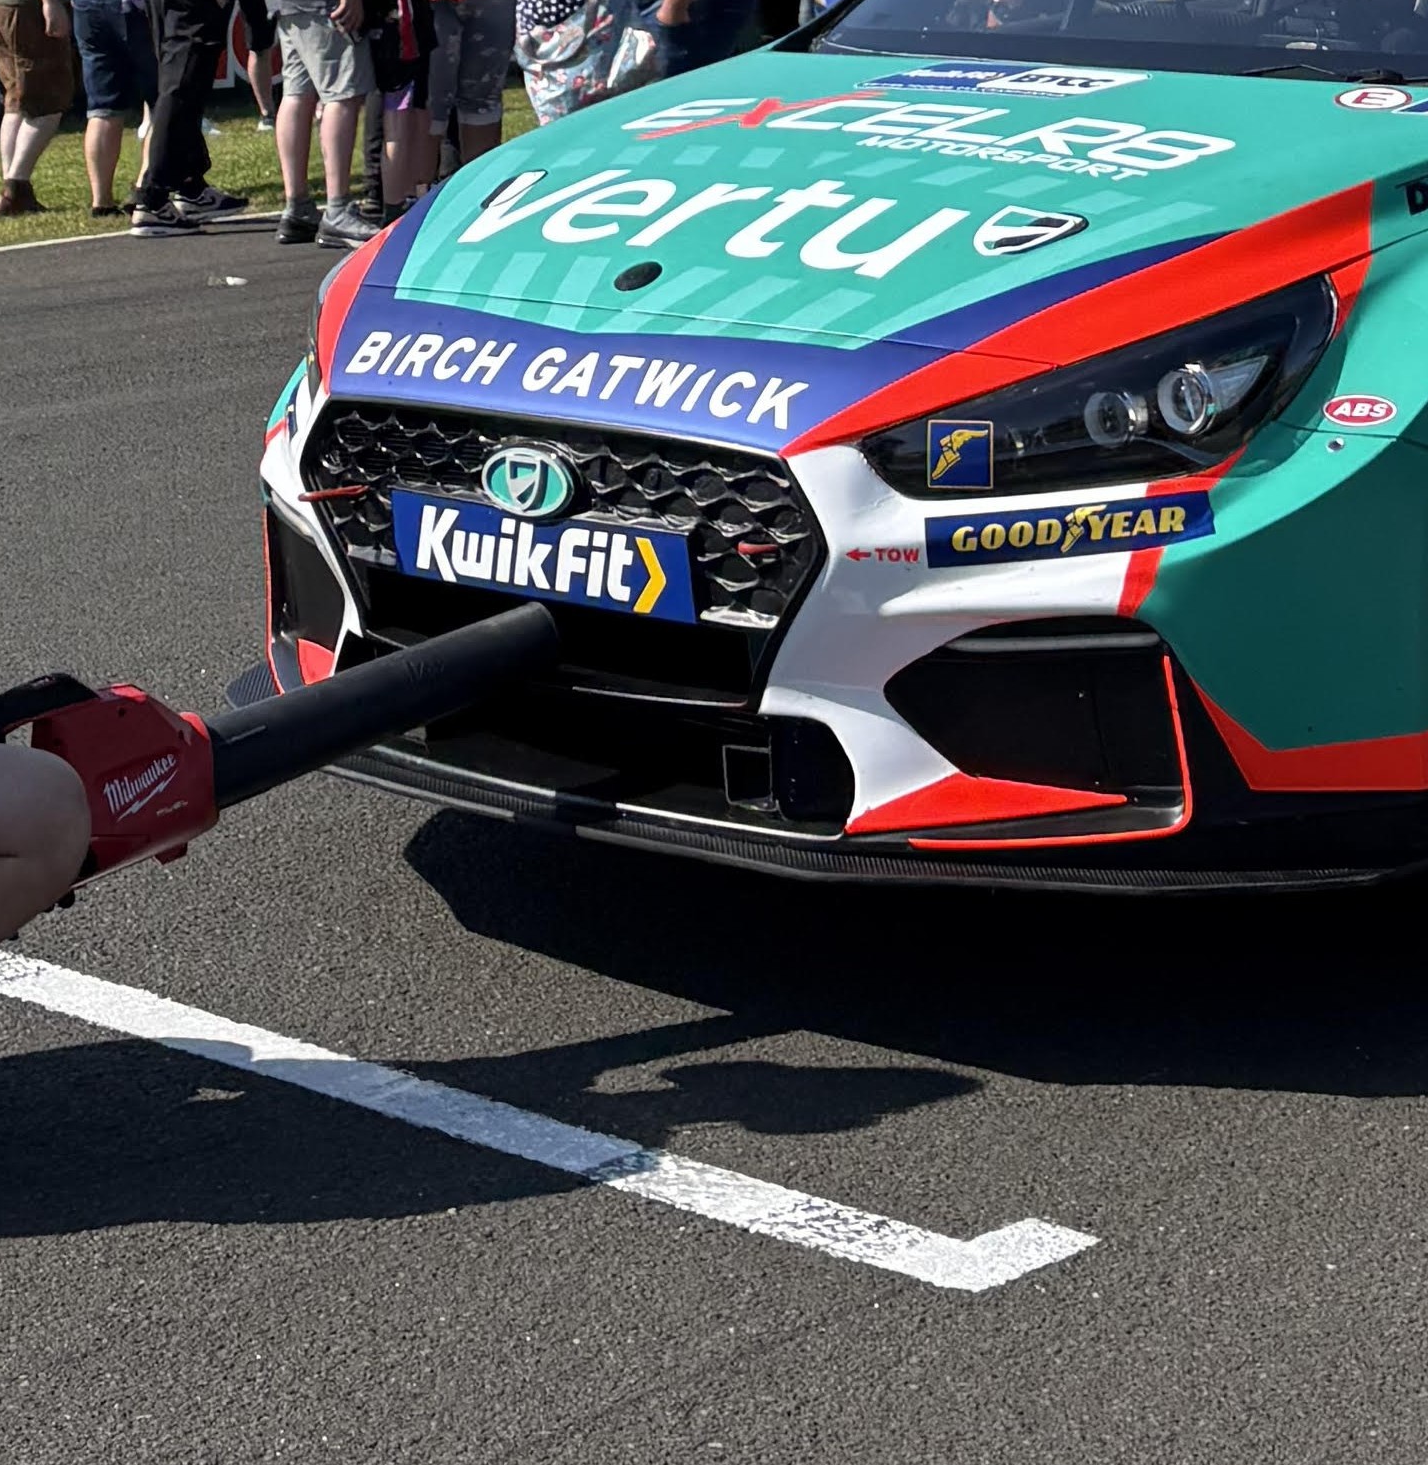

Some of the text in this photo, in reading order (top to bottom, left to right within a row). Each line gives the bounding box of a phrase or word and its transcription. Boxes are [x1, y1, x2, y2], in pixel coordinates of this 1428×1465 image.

[1008, 73, 1117, 89] BTCC
[621, 90, 1236, 173] EXCELR8
[856, 135, 1149, 182] MOTORSPORT
[345, 331, 809, 431] BIRCH GATWICK
[1333, 401, 1389, 417] ABS
[874, 547, 920, 563] TOW
[103, 753, 177, 815] Milwaukee
